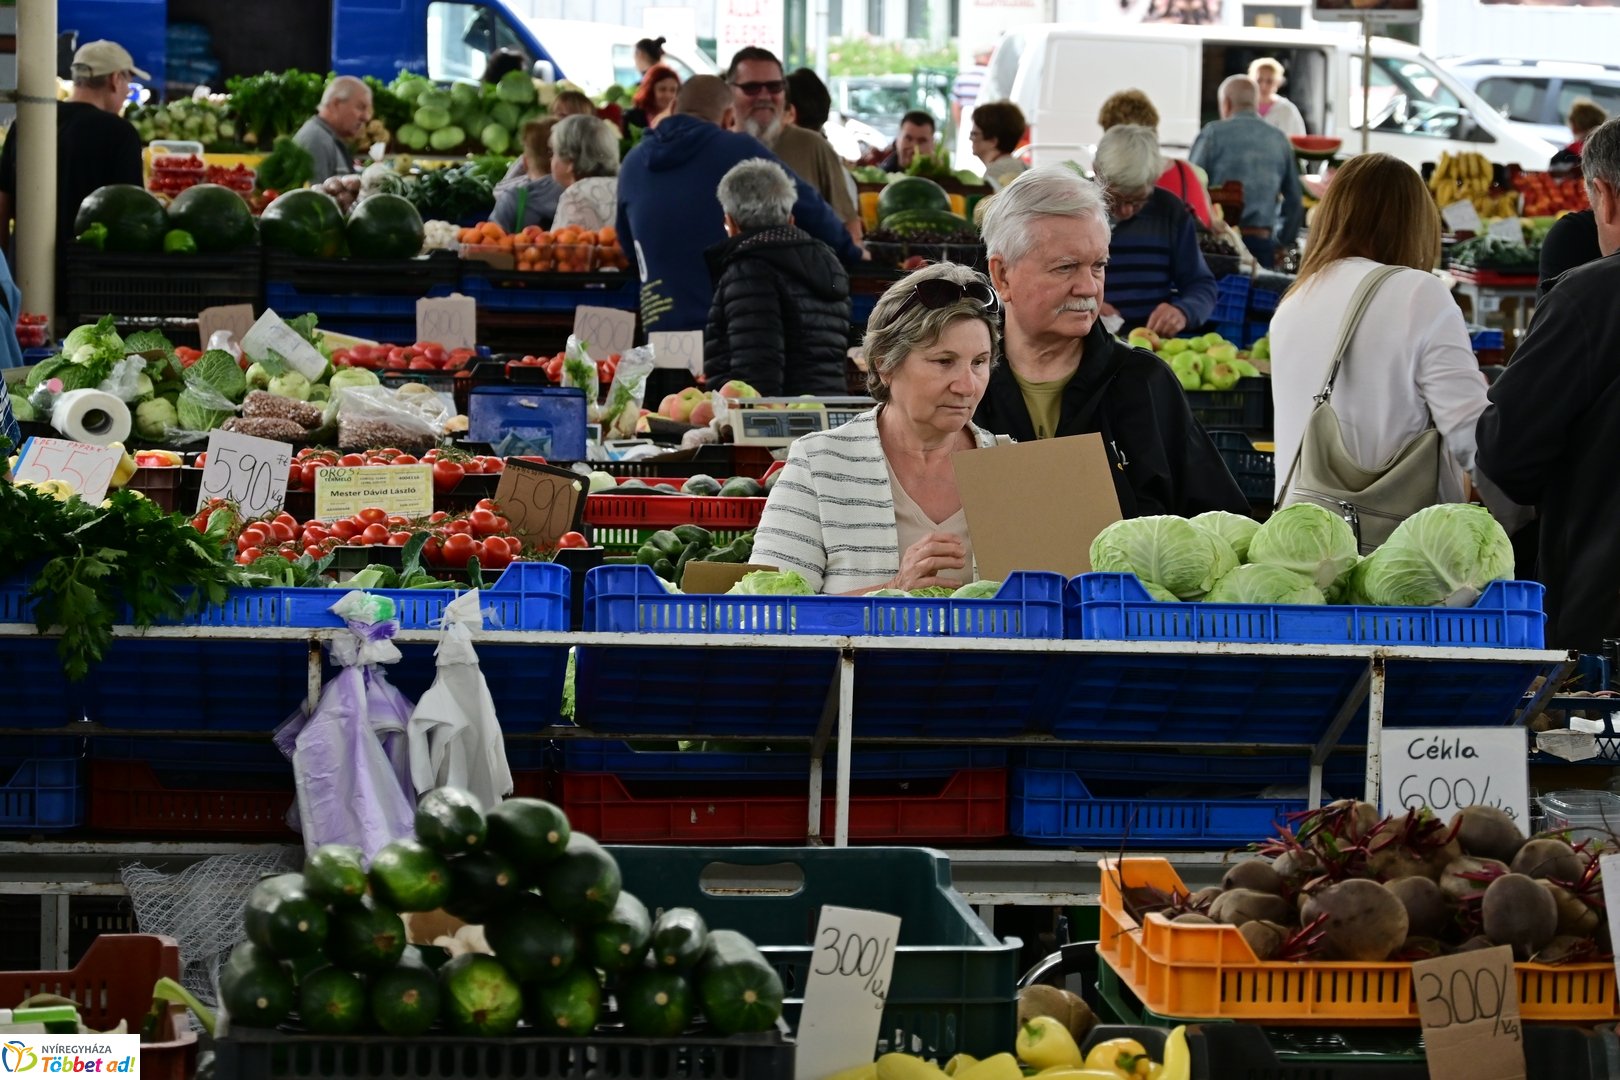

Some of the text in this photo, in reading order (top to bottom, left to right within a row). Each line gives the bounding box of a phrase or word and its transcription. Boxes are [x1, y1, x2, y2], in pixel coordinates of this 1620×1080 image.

[32, 446, 115, 496] 550
[204, 447, 272, 511] 590
[330, 487, 416, 497] Mester Dávid László
[508, 472, 572, 539] 590
[1407, 736, 1479, 760] Cékla
